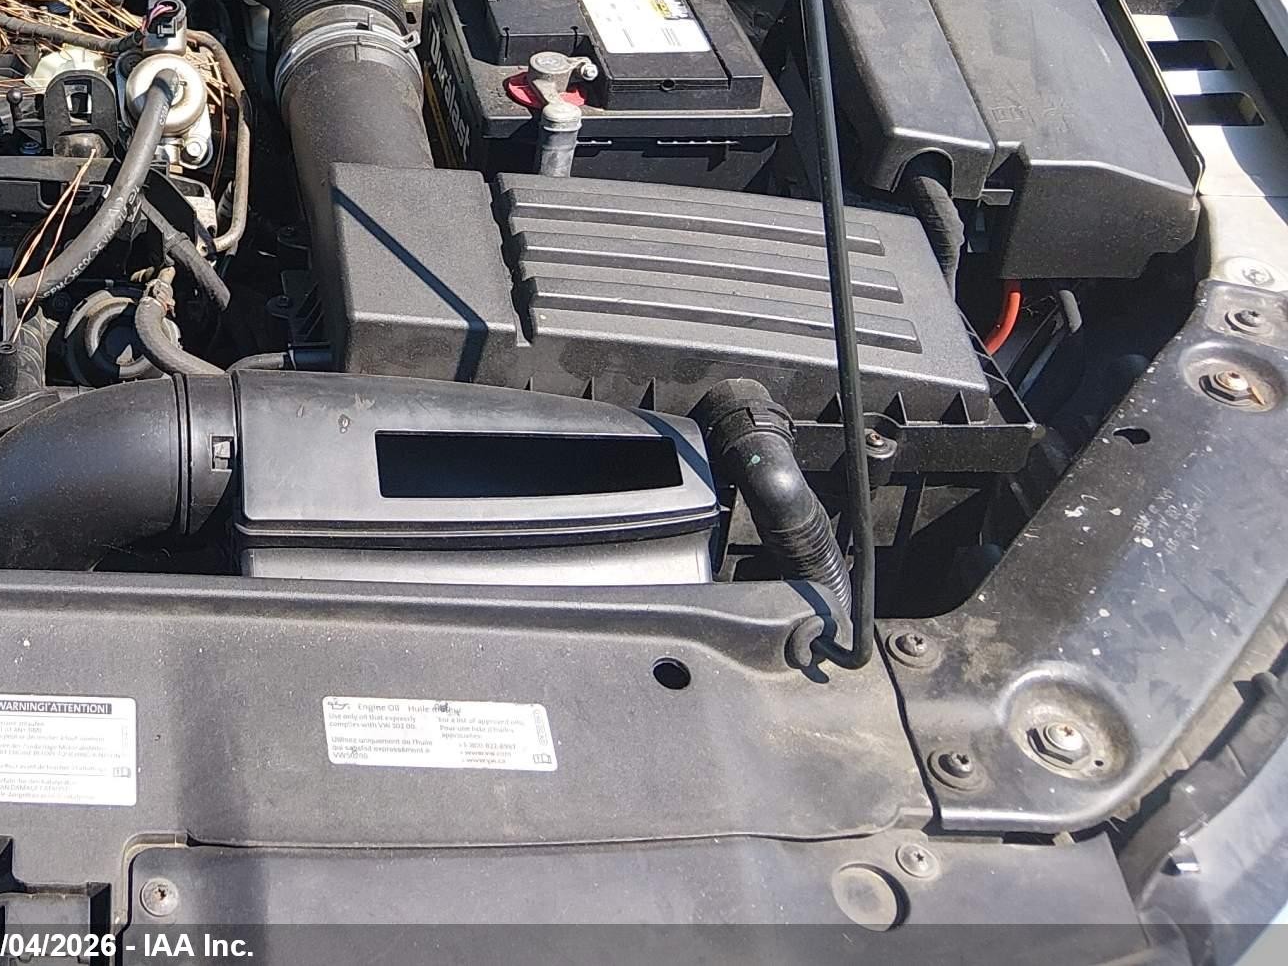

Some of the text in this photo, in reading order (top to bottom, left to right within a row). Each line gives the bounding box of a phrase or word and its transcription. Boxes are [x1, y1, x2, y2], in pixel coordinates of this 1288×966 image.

[50, 702, 109, 715] ATTENTION!
[357, 703, 386, 713] Engine
[388, 703, 400, 712] Oil
